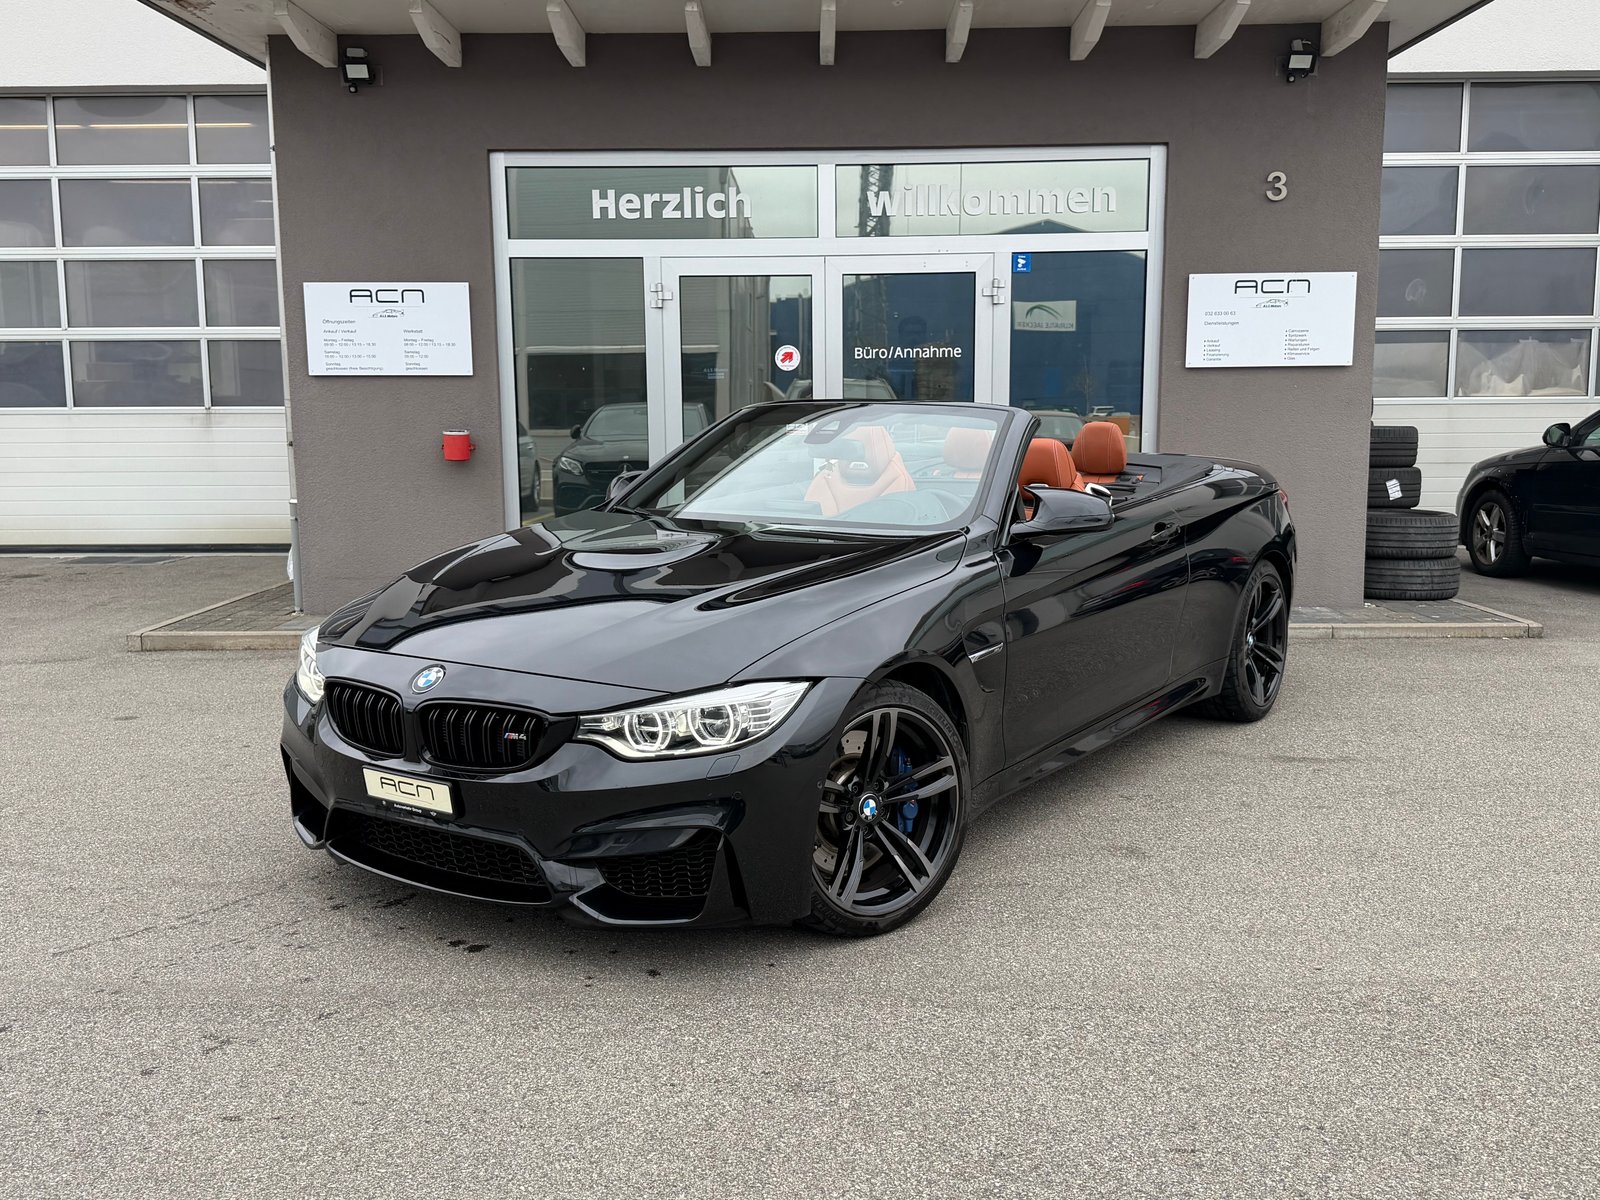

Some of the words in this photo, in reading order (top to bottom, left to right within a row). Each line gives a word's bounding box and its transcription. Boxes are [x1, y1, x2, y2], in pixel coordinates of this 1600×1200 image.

[1265, 171, 1288, 201] 3
[591, 185, 753, 219] Herzlich
[866, 184, 1118, 217] willkommen
[350, 289, 425, 303] ACN
[1234, 279, 1311, 294] ACN
[854, 346, 962, 359] Büro/Annahme
[380, 776, 435, 801] ACN
